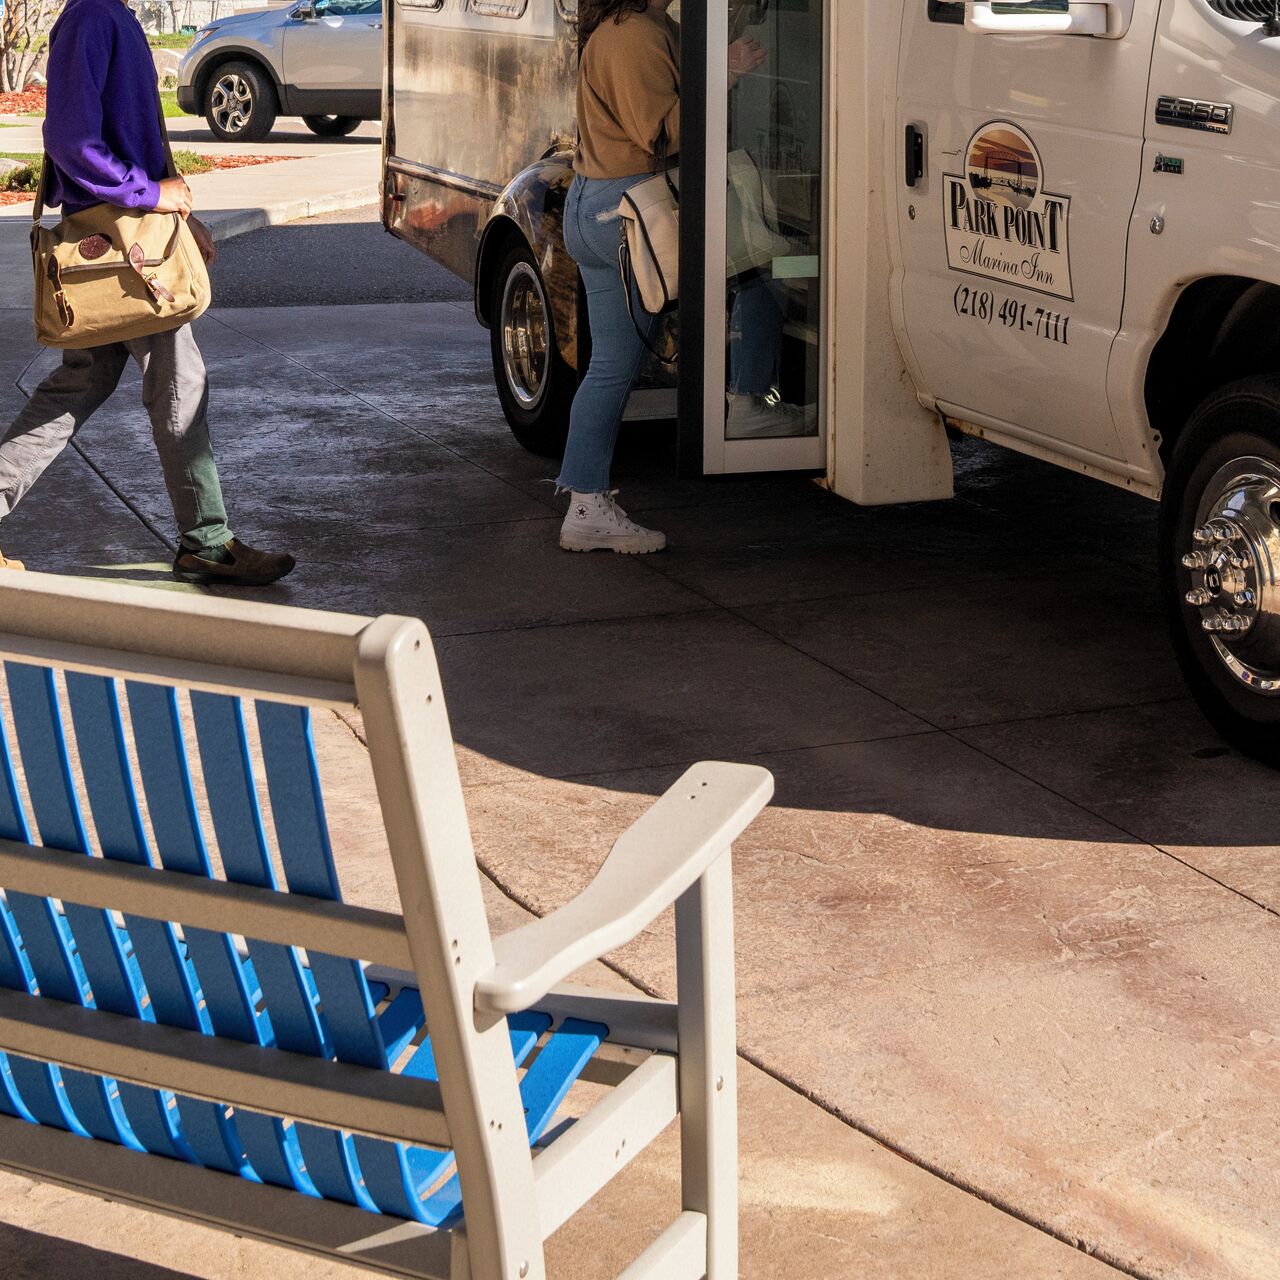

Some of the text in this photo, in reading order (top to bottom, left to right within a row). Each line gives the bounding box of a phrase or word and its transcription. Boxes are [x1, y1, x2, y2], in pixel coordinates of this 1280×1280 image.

[949, 180, 1063, 255] PARK POINT
[959, 238, 1054, 286] Marina Inn
[953, 283, 1070, 345] (218) 491-7111
